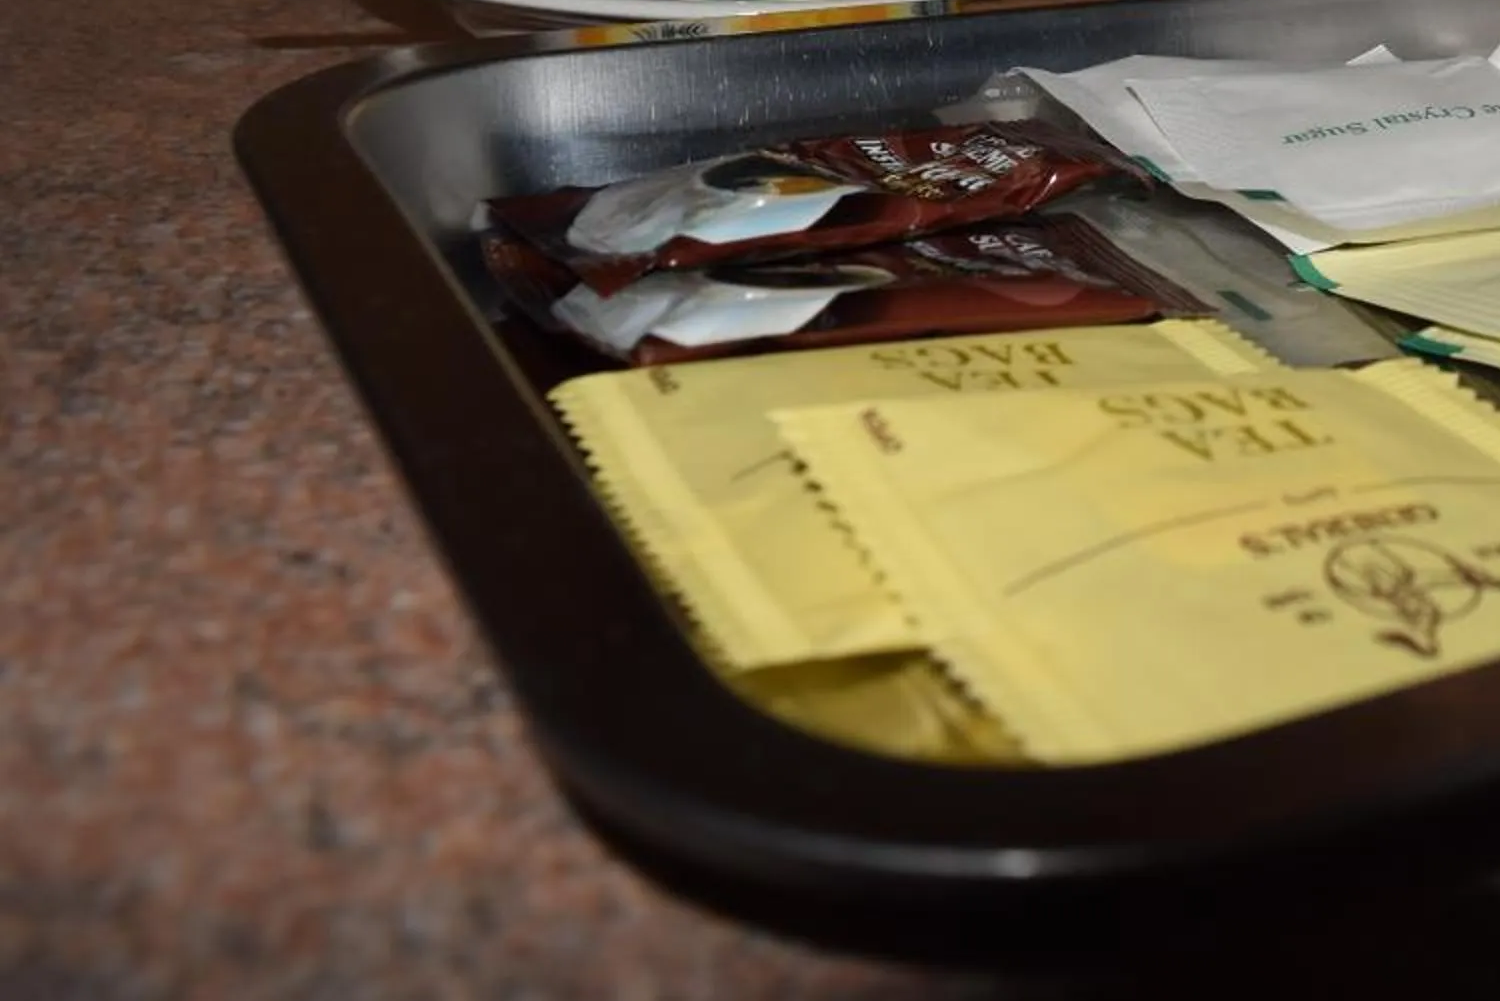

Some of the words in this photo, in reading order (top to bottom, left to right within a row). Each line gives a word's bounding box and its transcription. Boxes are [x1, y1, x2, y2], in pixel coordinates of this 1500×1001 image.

[1373, 105, 1476, 130] Crystal
[1281, 120, 1369, 146] Sugar
[870, 342, 1074, 369] BAGS
[1099, 387, 1310, 428] BAGS
[1162, 419, 1335, 461] TEA
